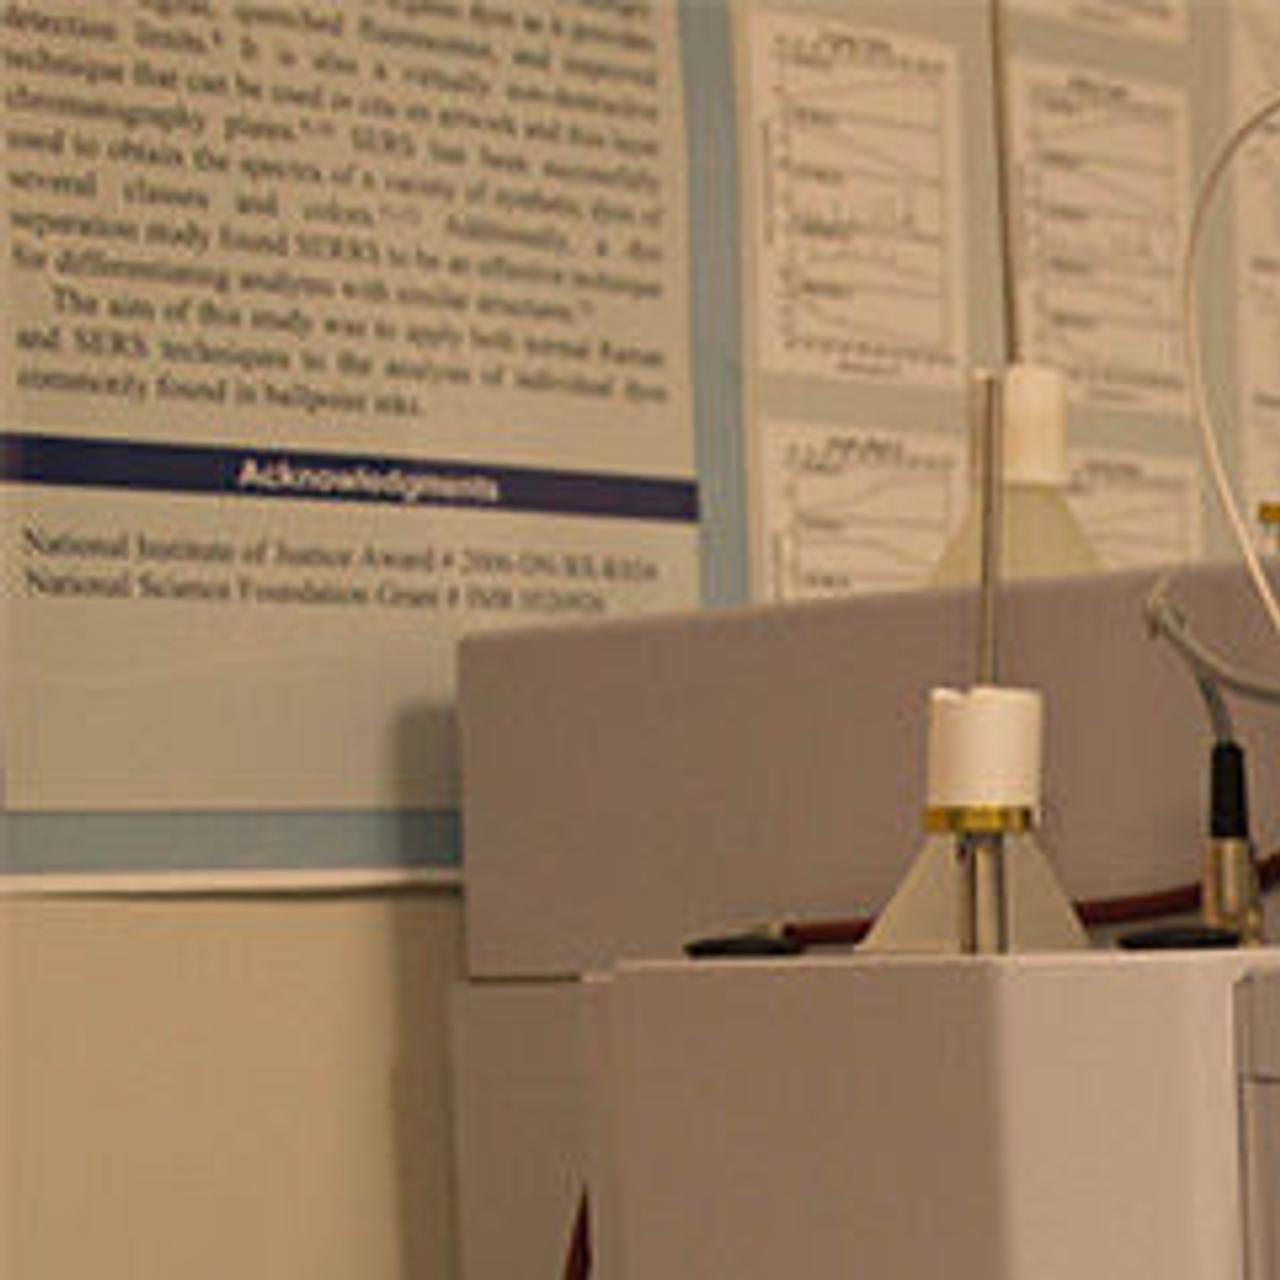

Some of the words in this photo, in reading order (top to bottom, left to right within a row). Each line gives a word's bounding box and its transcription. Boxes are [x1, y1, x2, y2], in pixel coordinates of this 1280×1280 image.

[238, 459, 499, 502] Acknowledgments
[21, 529, 130, 560] National
[274, 540, 353, 569] Justice
[361, 544, 436, 573] Award
[24, 567, 132, 599] National
[138, 573, 231, 602] Science
[237, 577, 369, 607] Foundation
